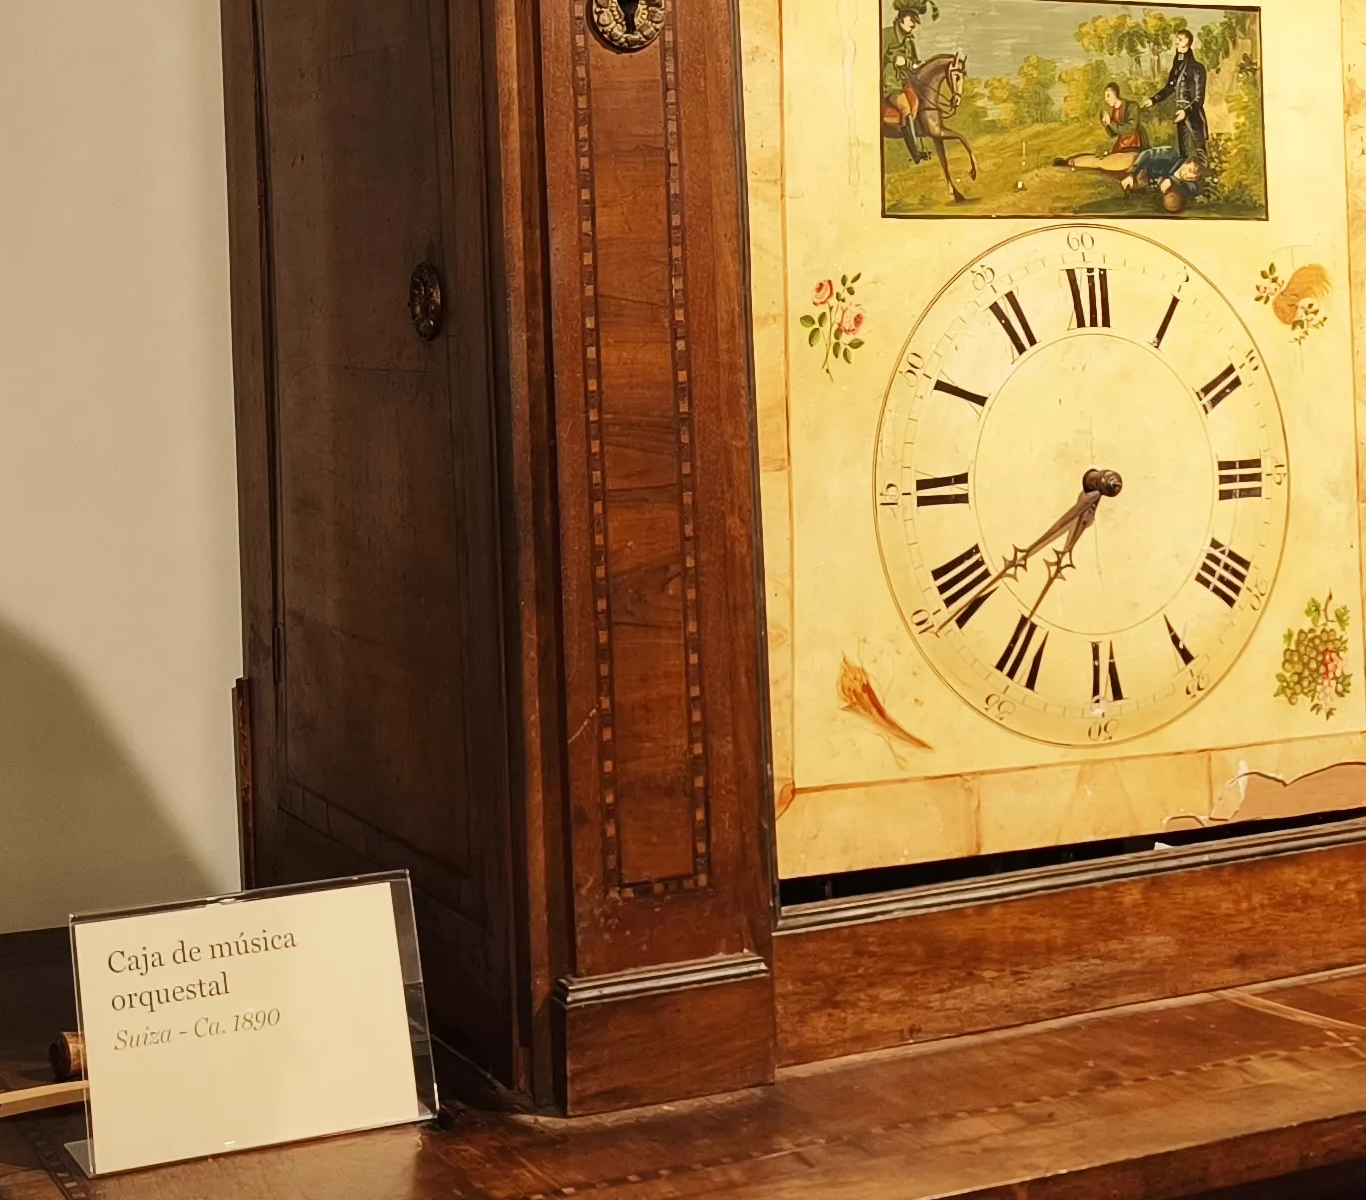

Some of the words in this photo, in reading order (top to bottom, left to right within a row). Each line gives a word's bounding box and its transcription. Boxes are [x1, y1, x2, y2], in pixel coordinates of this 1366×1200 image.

[1066, 231, 1095, 251] 60
[970, 264, 996, 291] 55
[1149, 293, 1182, 350] I
[898, 352, 925, 388] 50
[1195, 361, 1243, 416] II
[1217, 457, 1262, 501] III
[1194, 537, 1252, 610] IIII
[107, 946, 166, 976] Caja
[172, 939, 202, 965] de
[208, 929, 297, 960] música
[111, 971, 230, 1013] orquestal
[114, 1025, 173, 1051] Suiza
[194, 1016, 227, 1038] Ca.
[232, 1007, 281, 1032] 1890
